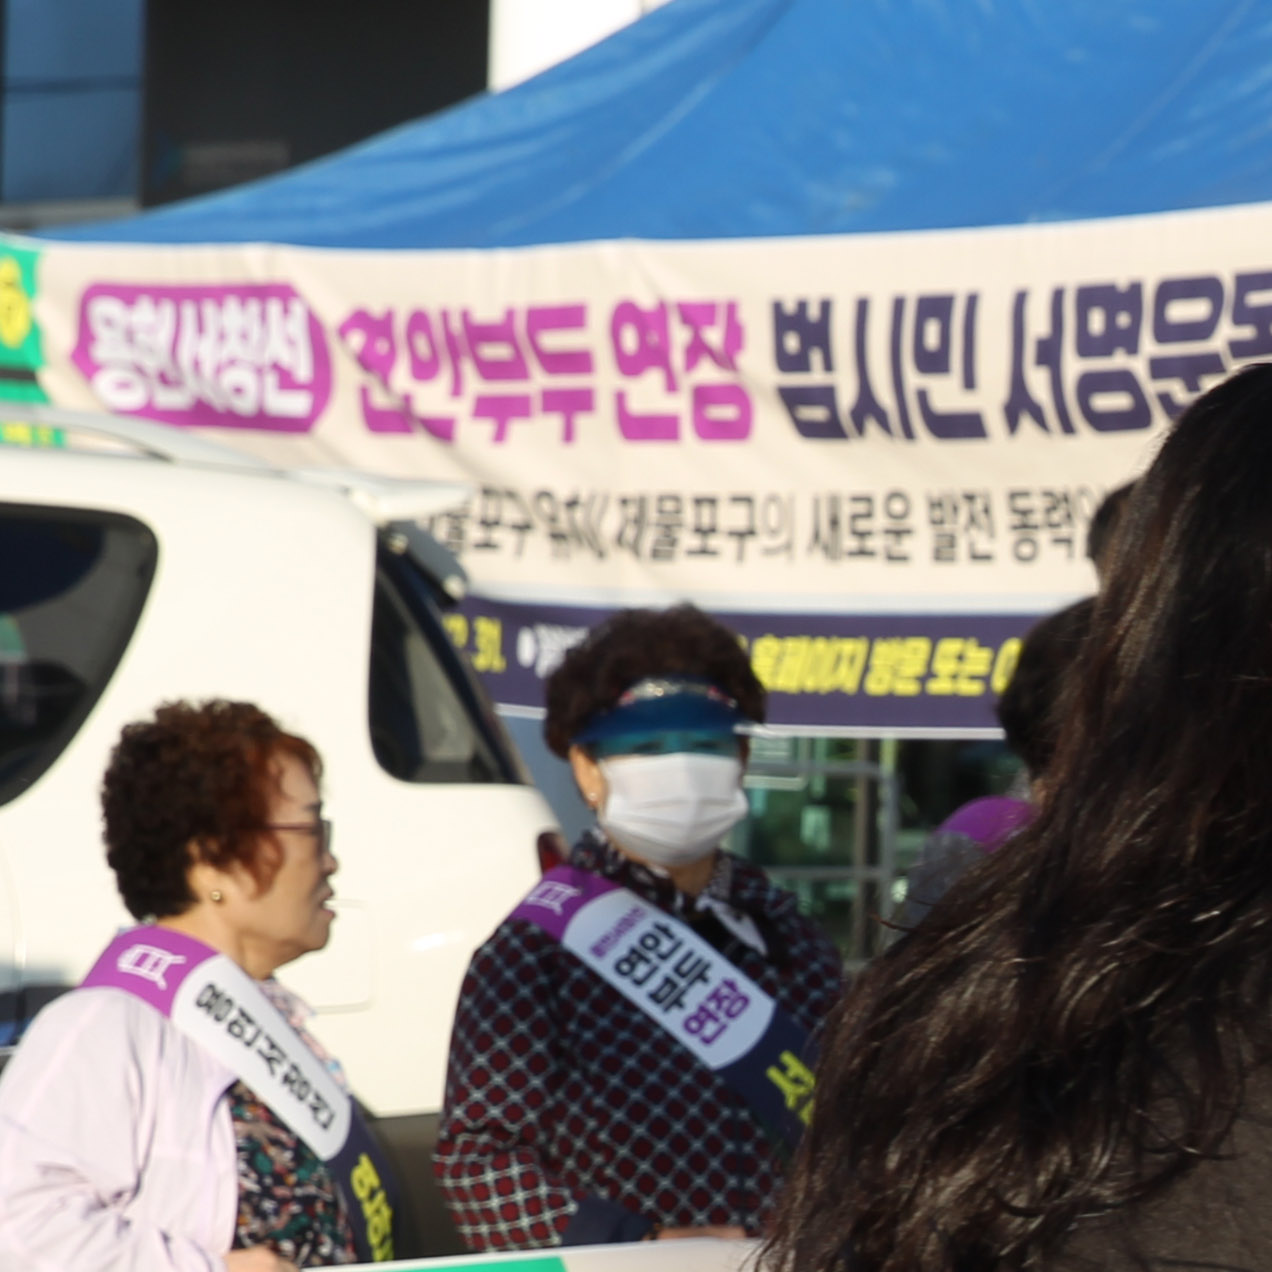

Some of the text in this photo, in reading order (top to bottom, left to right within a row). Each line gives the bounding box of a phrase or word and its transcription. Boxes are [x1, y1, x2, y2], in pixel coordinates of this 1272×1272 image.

[338, 304, 596, 444] 연안부두
[611, 298, 753, 443] 연장
[772, 292, 990, 442] 범시민
[806, 490, 912, 563] 새로운
[925, 490, 996, 563] 발전
[613, 922, 683, 987] 연안
[645, 949, 713, 1014] 부두
[682, 977, 753, 1046] 연장
